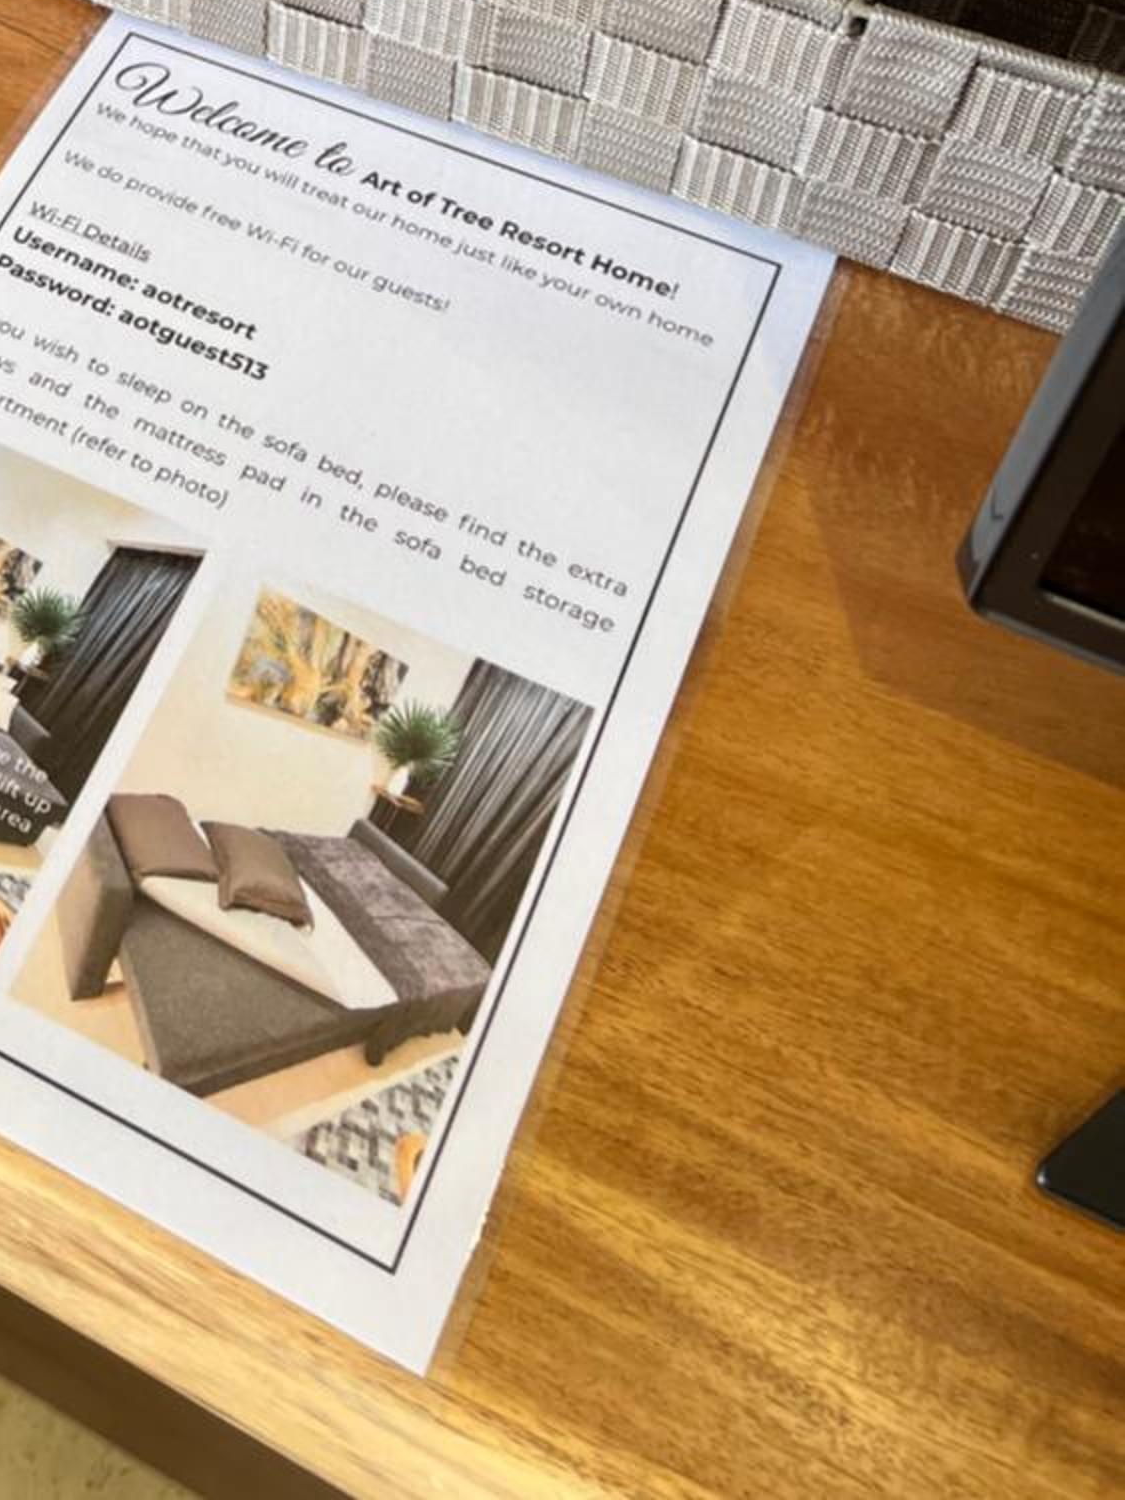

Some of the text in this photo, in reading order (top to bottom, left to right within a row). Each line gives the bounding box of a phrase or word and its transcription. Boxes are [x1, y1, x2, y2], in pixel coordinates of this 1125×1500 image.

[29, 201, 152, 263] Wi-Fi Details
[64, 150, 451, 313] We do provide free Wi-Fi for our guests!
[96, 102, 714, 348] We hope that you will treat our home just like your own home
[115, 62, 680, 301] Welcome to Art of Tree Resort Home!
[13, 226, 257, 340] Username: aotresort
[118, 309, 270, 381] aotguest513
[28, 371, 72, 397] and
[83, 392, 120, 420] the
[133, 416, 228, 468] mattress
[240, 464, 287, 492] pad
[300, 486, 323, 509] in
[339, 504, 379, 533] the
[394, 528, 442, 561] sofa
[459, 554, 508, 588] bed
[523, 583, 616, 633] storage
[33, 334, 80, 364] wish
[87, 356, 110, 376] to
[116, 371, 173, 404] sleep
[180, 399, 209, 420] on
[217, 413, 255, 440] the
[262, 433, 308, 463] sofa
[317, 454, 365, 490] bed,
[374, 482, 450, 522] please
[458, 514, 508, 548] find
[517, 539, 558, 568] the
[568, 564, 628, 598] extra
[70, 425, 128, 462] (refer
[130, 453, 154, 474] to
[155, 464, 229, 510] photo)
[14, 756, 48, 783] the
[24, 792, 51, 814] up
